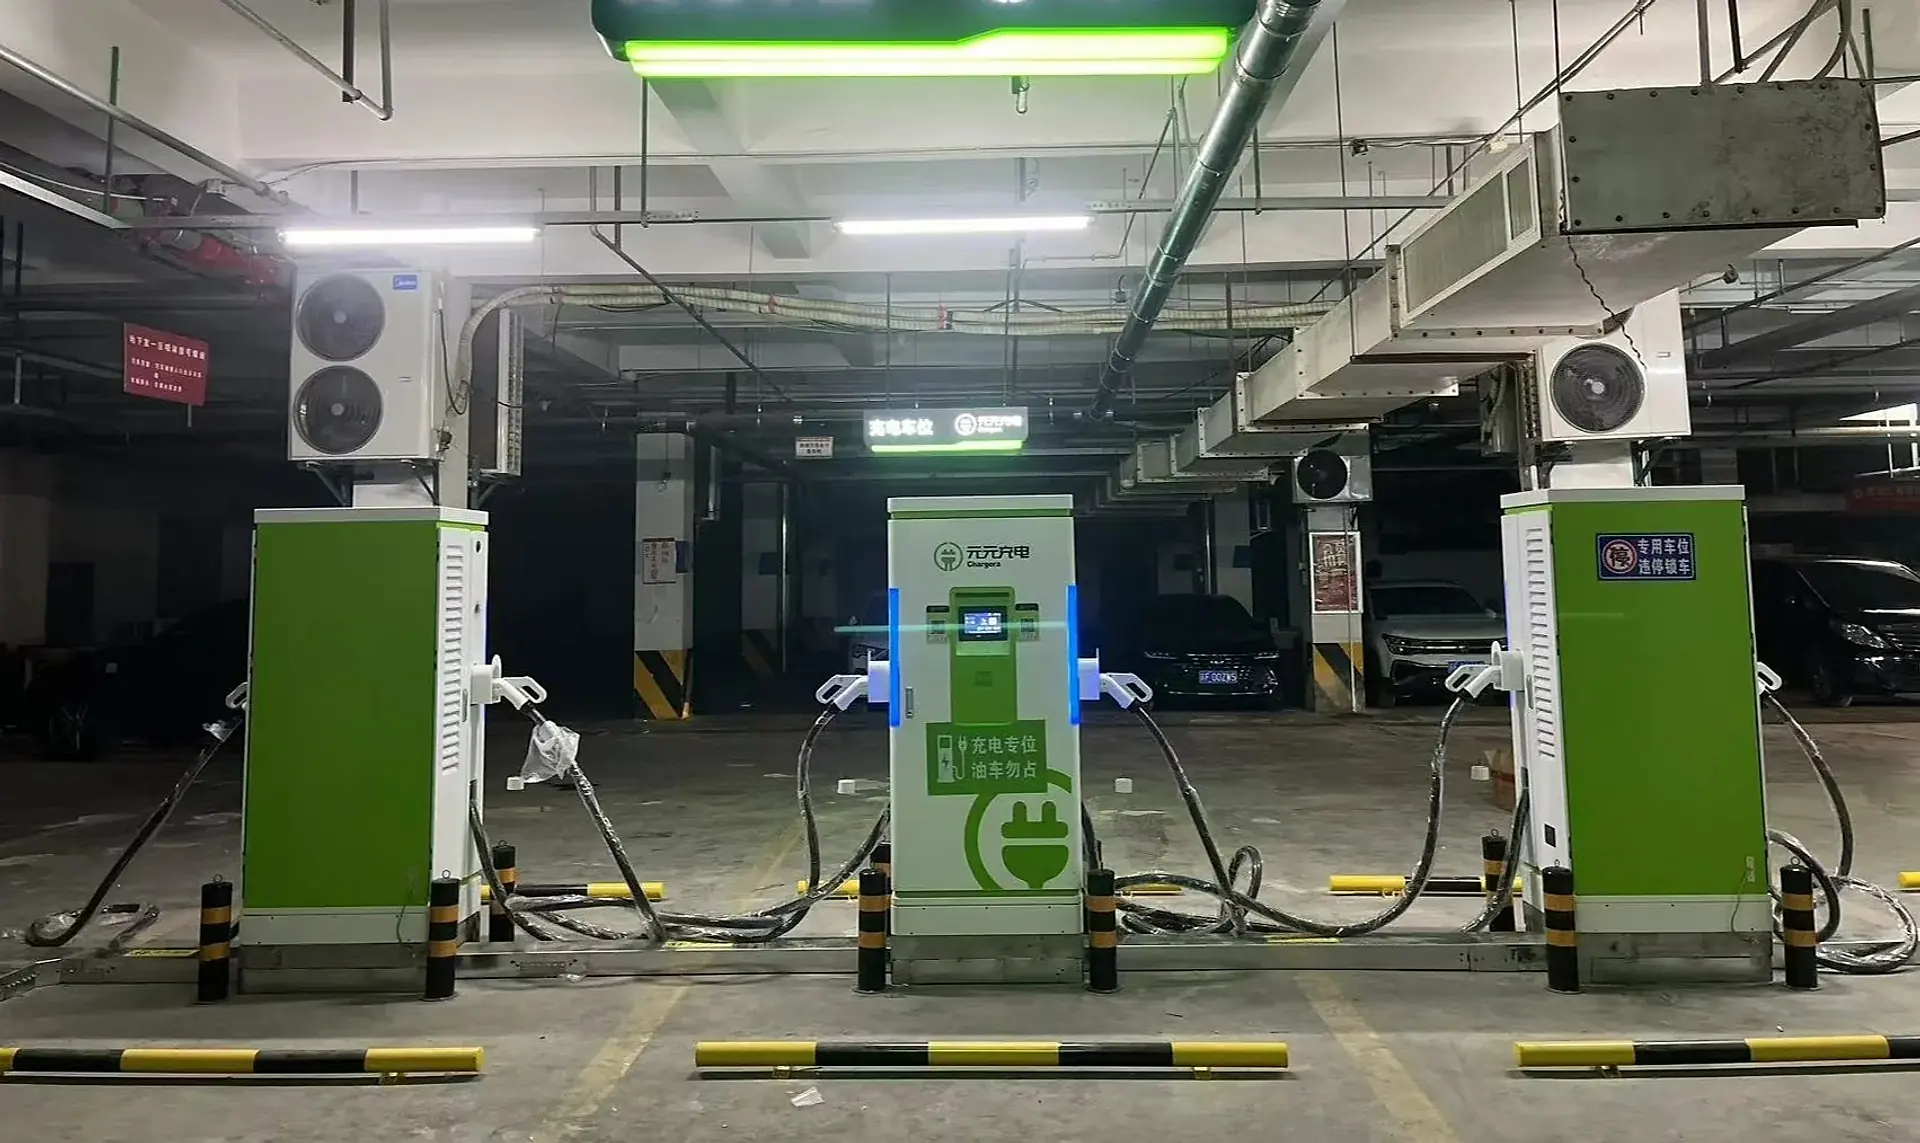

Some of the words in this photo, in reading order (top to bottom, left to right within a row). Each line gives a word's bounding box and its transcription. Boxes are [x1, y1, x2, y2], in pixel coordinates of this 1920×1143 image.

[868, 418, 934, 437] 充电车位
[966, 545, 1030, 559] 元元充电
[1637, 538, 1689, 555] 专用车位
[1609, 546, 1631, 568] 停
[971, 735, 1038, 755] 充电专位
[971, 760, 1037, 779] 油车勿占
